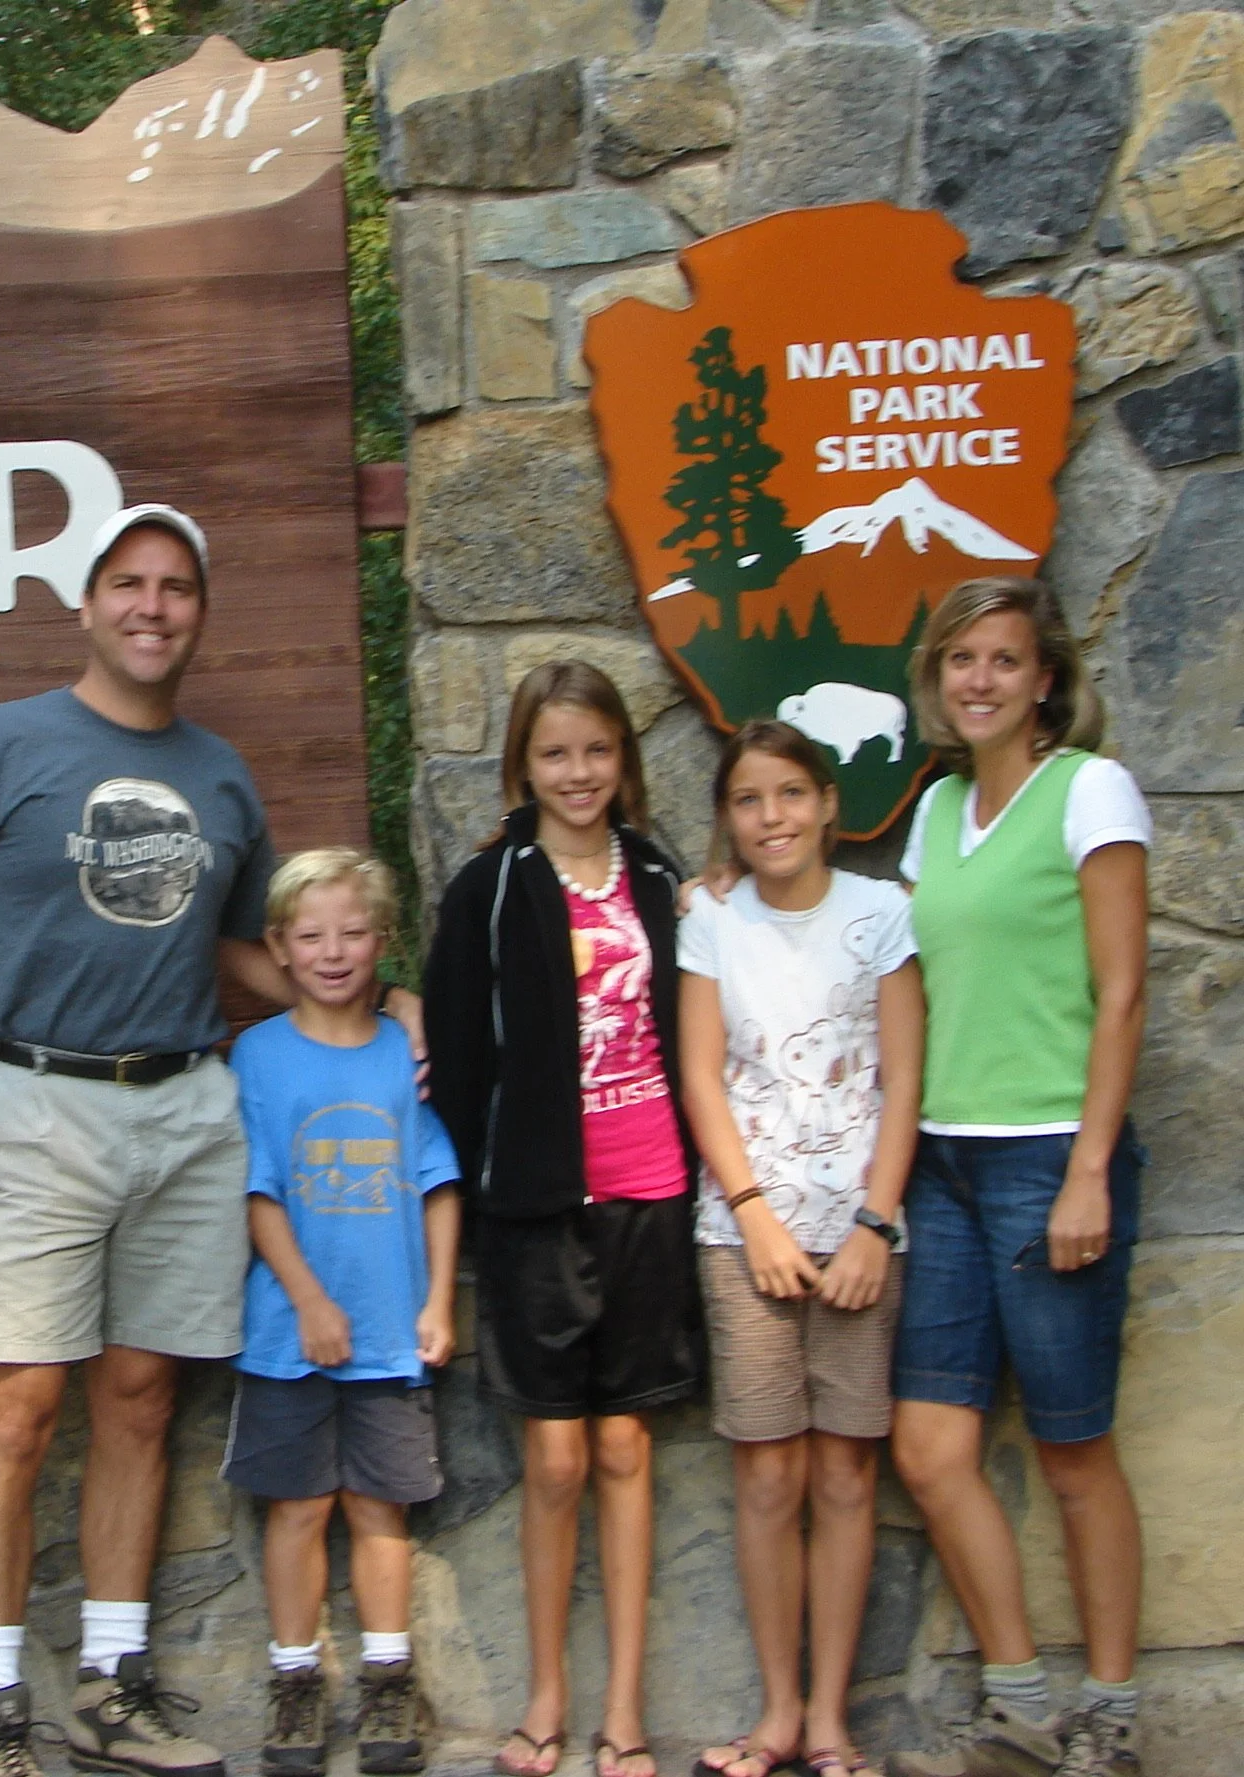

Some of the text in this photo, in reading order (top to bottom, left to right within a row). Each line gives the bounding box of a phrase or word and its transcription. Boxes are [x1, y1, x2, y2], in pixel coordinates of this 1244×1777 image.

[787, 333, 1044, 380] NATIONAL
[850, 383, 982, 424] PARK
[816, 428, 1021, 473] SERVICE
